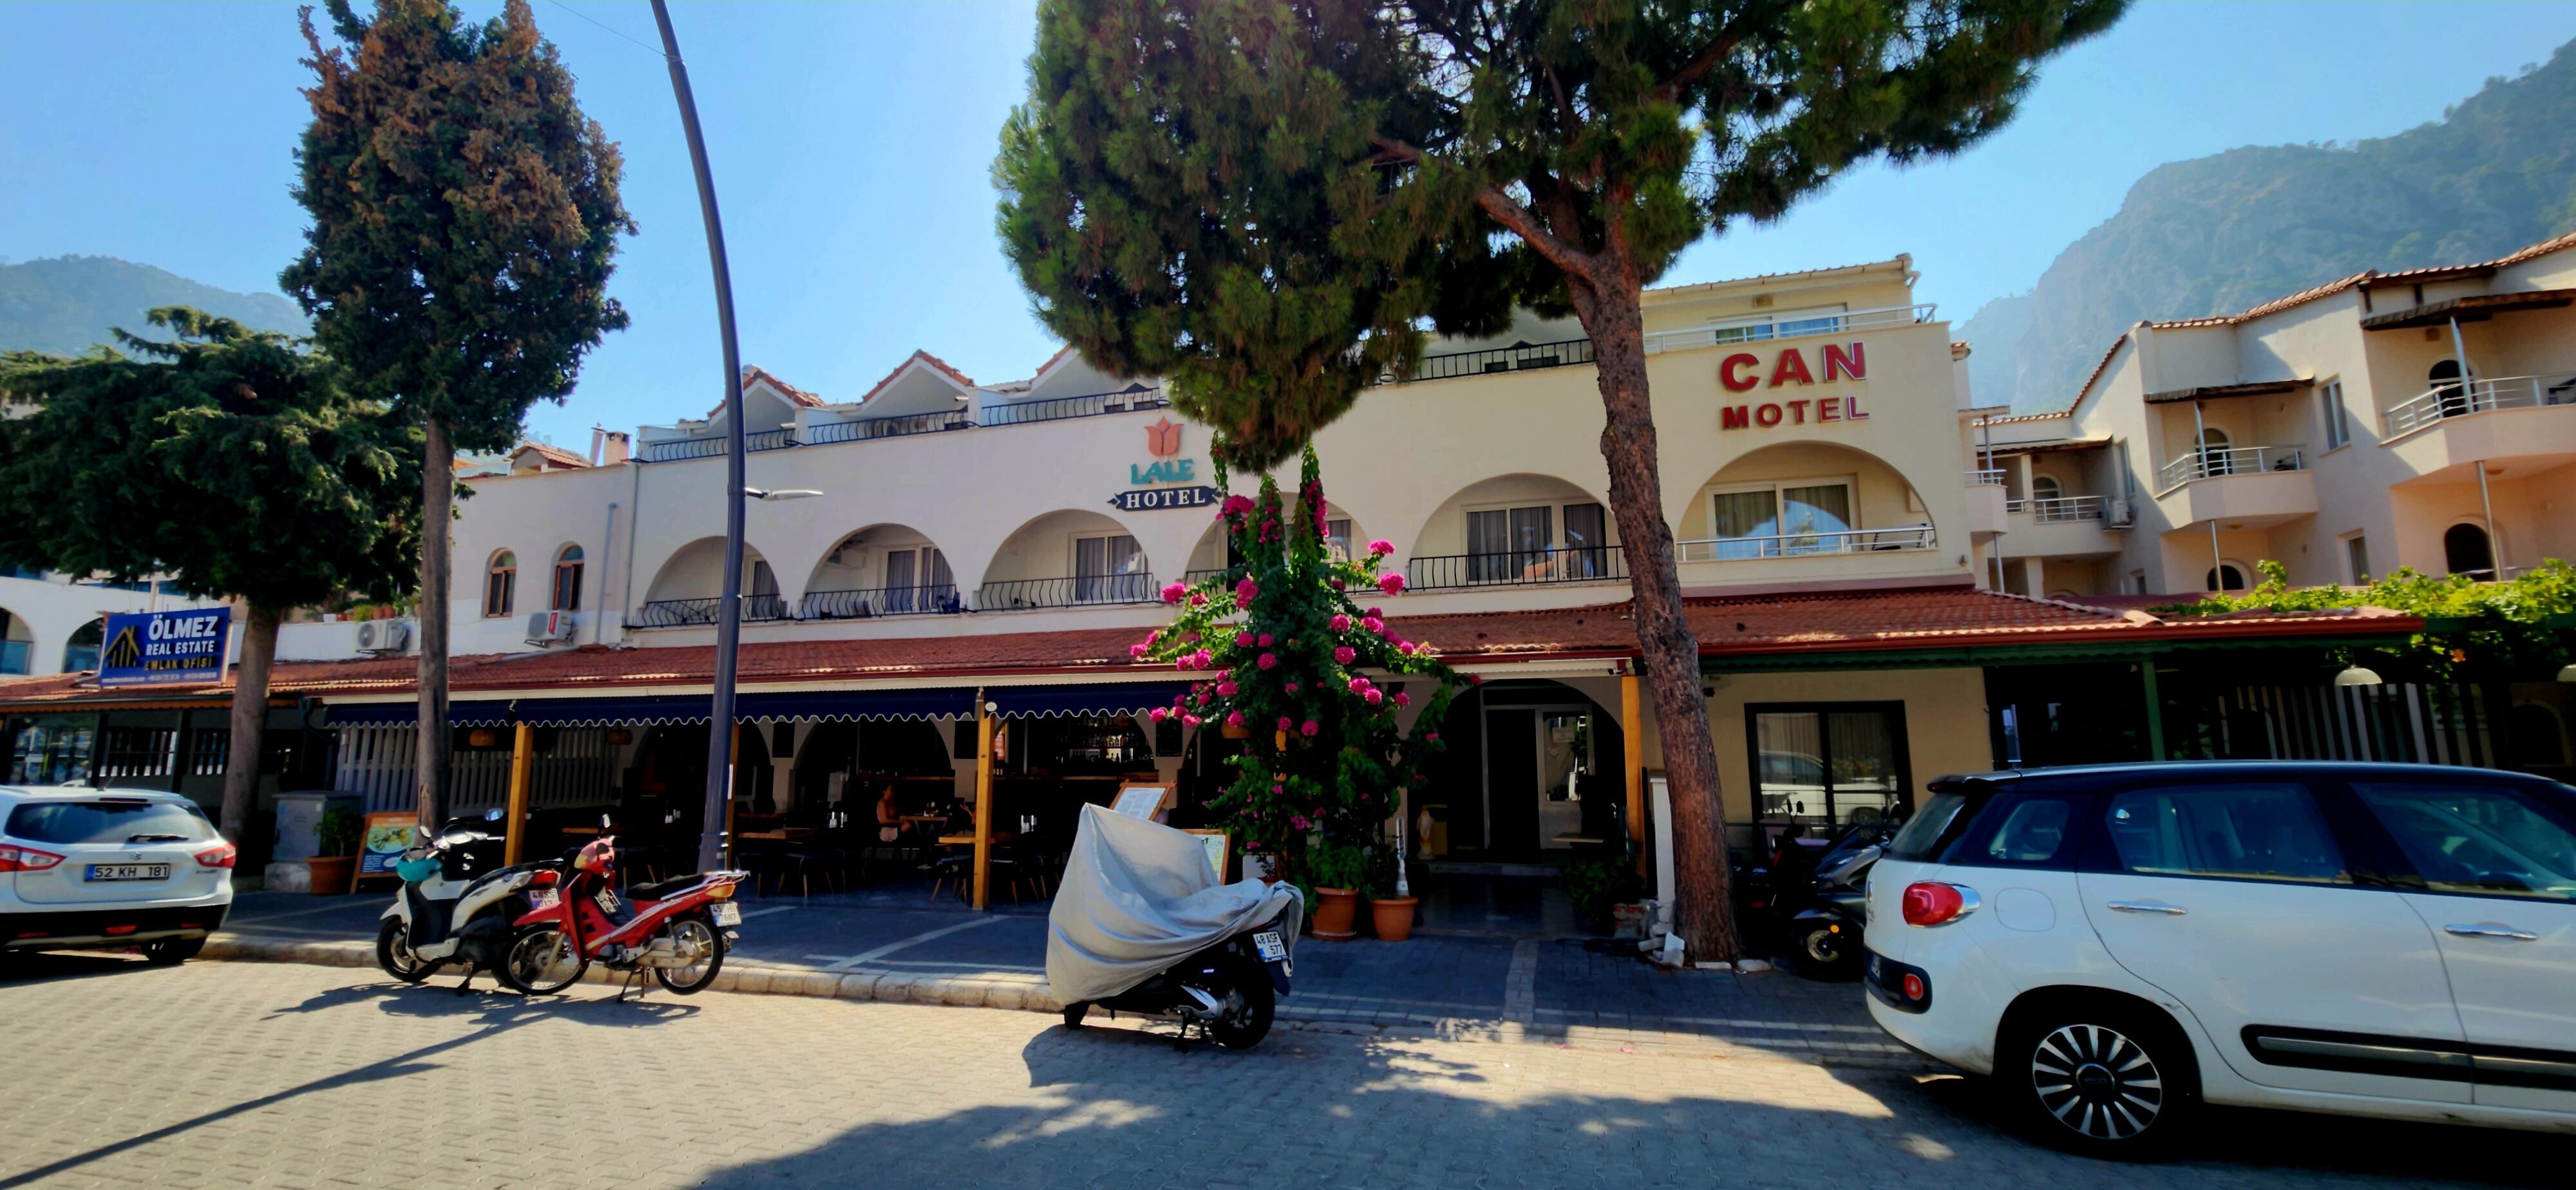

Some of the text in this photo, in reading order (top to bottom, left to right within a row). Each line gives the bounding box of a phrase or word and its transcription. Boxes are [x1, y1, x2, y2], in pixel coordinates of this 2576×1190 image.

[1721, 342, 1866, 393] CAN
[1723, 396, 1870, 430] MOTEL
[1131, 458, 1195, 485] LALE
[1126, 489, 1206, 508] HOTEL
[148, 614, 218, 641] ÖLMEZ
[146, 640, 214, 656] REAL ESTATE
[146, 659, 178, 670] EMLAK
[95, 867, 167, 877] 52 KH 181
[719, 913, 736, 922] 7687
[1256, 935, 1265, 945] 48
[1269, 944, 1282, 955] 577
